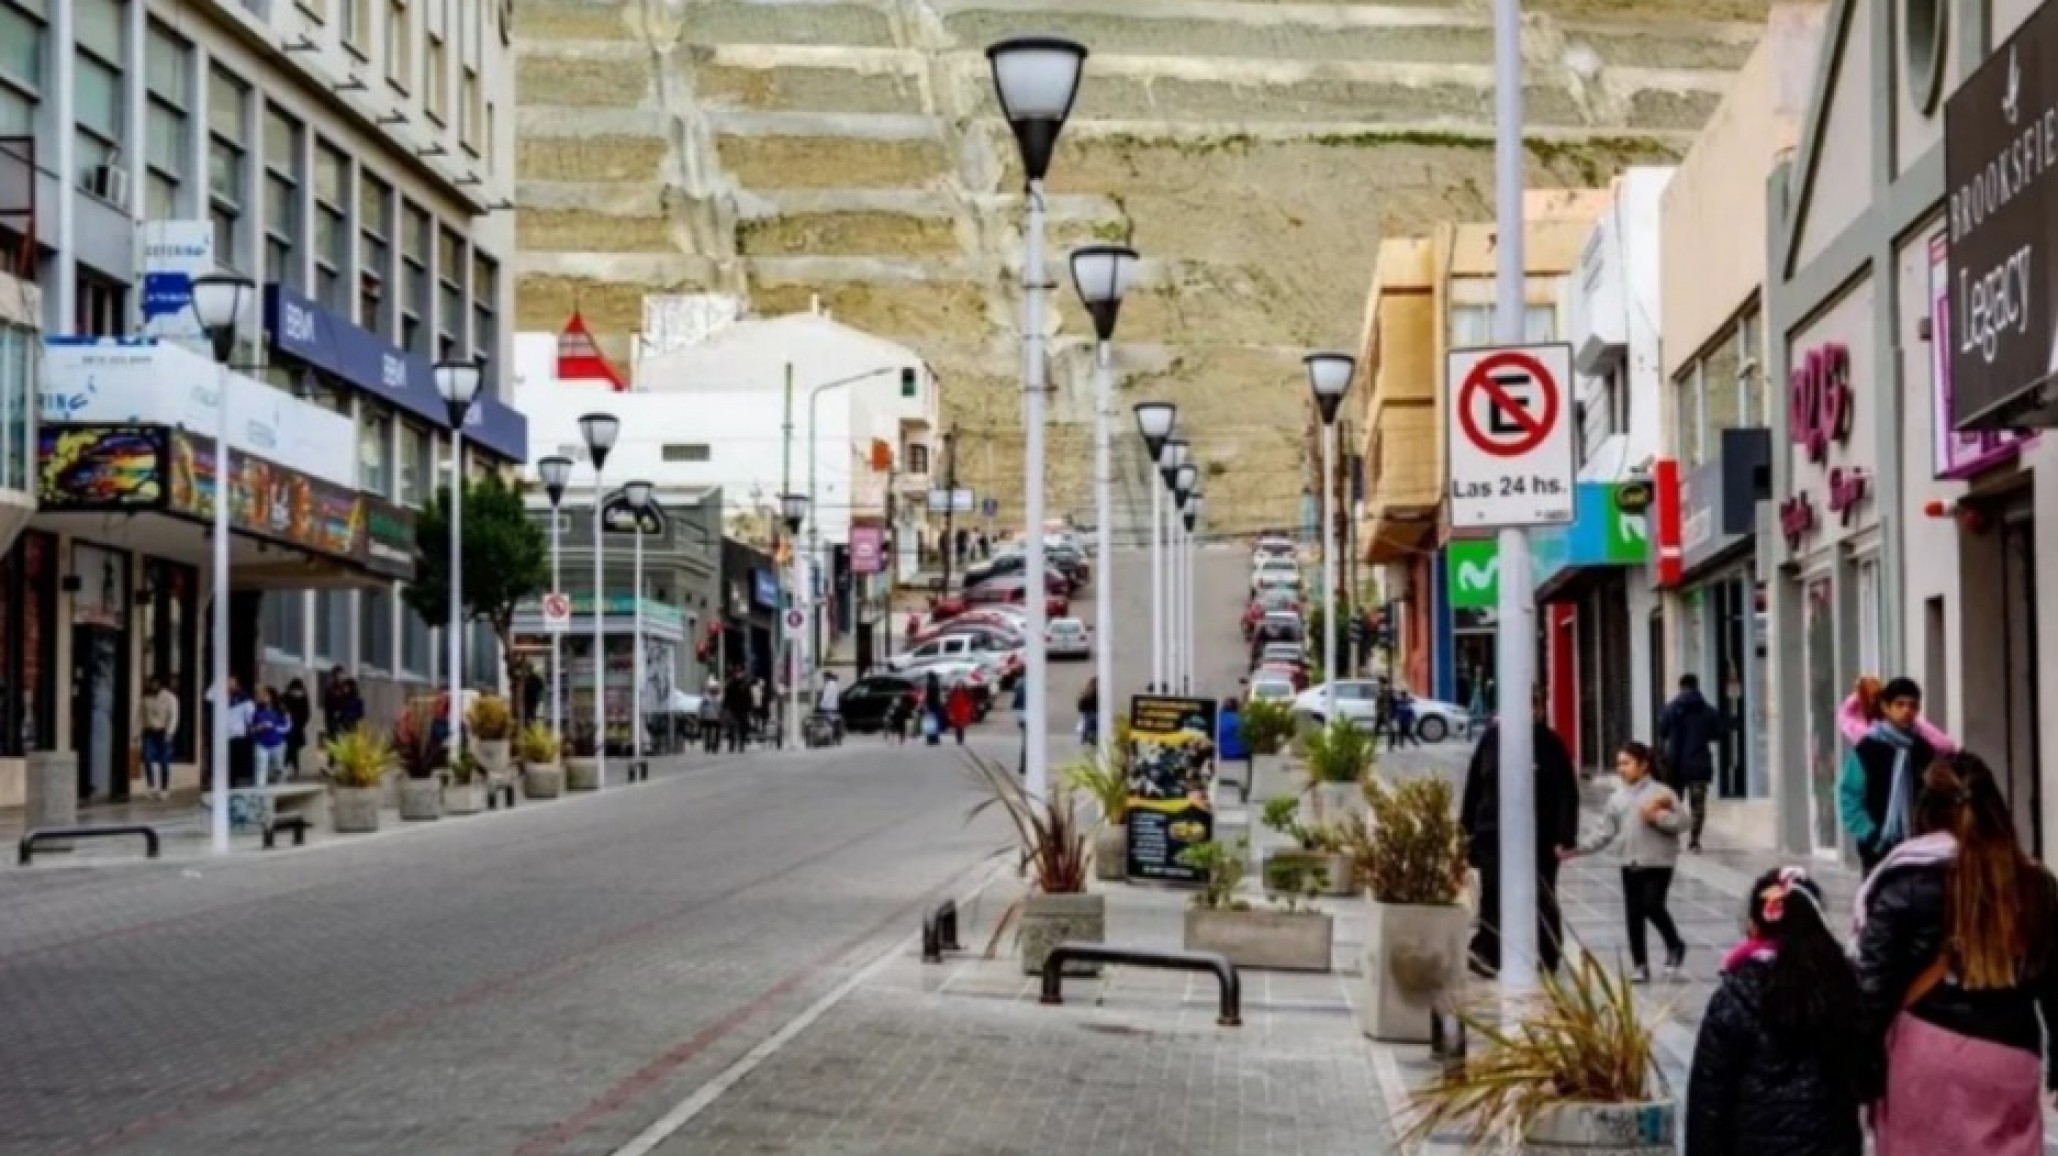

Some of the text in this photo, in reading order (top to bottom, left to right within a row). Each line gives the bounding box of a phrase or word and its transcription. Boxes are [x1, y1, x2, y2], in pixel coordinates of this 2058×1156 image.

[1959, 243, 2032, 363] Legacy
[1489, 374, 1531, 435] E
[1453, 474, 1568, 498] Las 24 hs.
